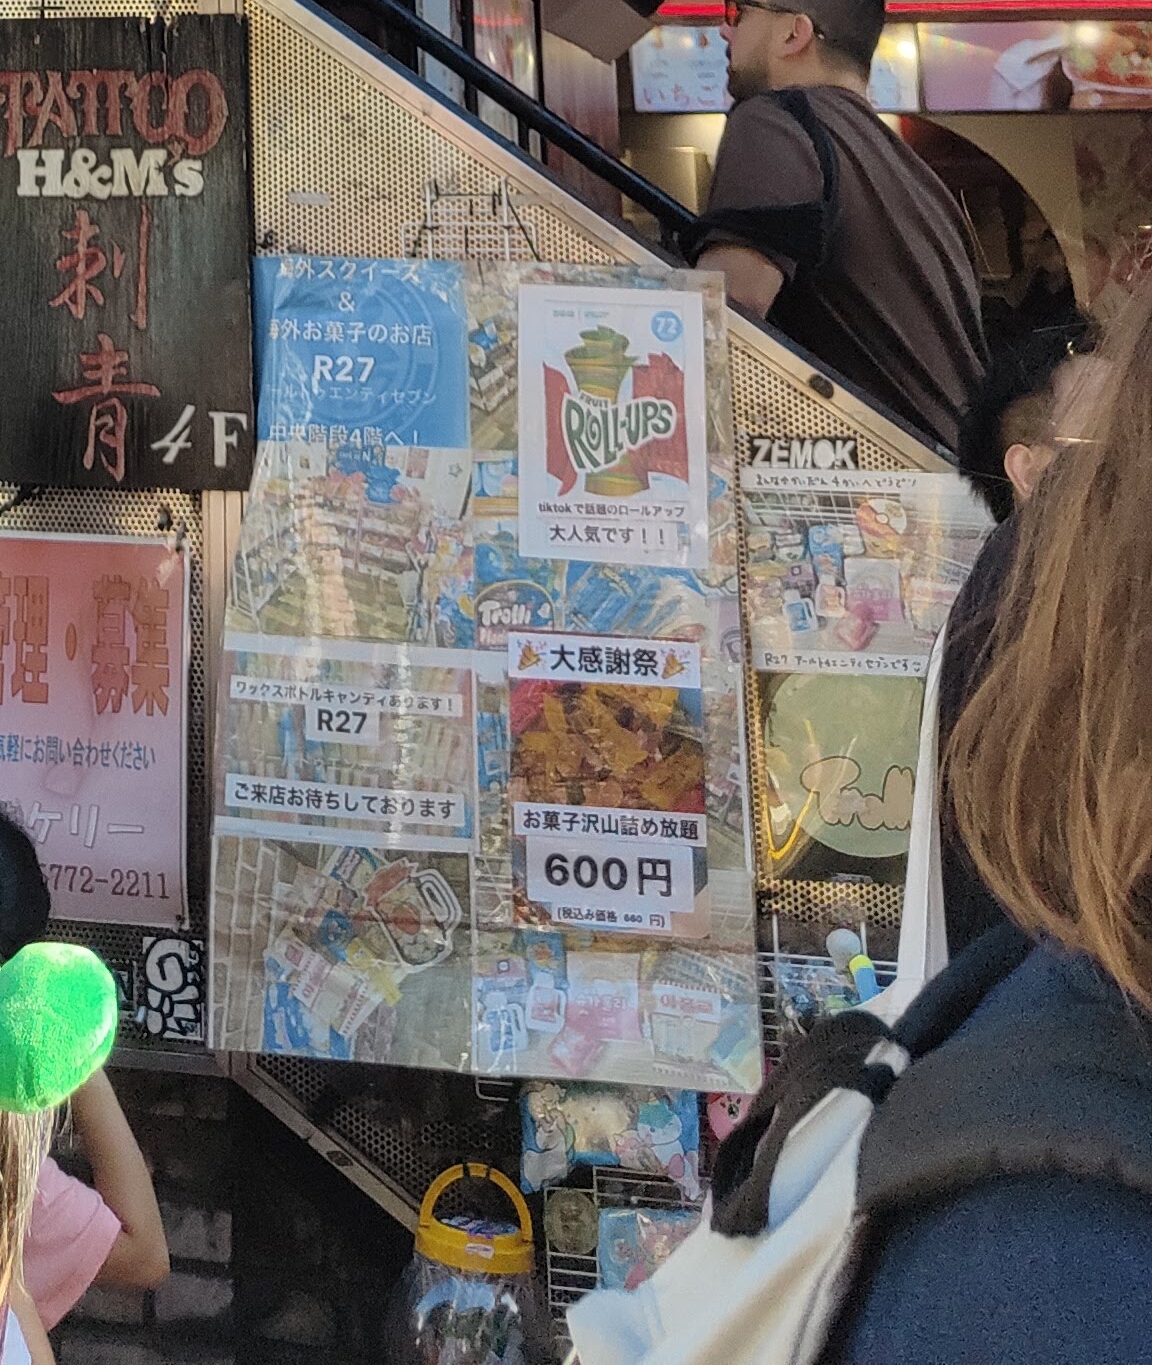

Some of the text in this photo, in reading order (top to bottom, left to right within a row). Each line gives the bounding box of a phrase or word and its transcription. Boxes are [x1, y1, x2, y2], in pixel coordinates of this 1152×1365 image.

[337, 292, 355, 312] &
[49, 206, 161, 483] 刺青
[313, 355, 375, 383] R27
[579, 394, 610, 409] FRUIT
[565, 399, 673, 469] ROLL-UPS
[753, 438, 857, 469] ZEMOK
[478, 600, 531, 626] Trolli
[550, 645, 659, 677] 大感謝祭
[764, 652, 788, 666] R27
[317, 708, 368, 734] R27
[235, 781, 456, 819] ご来店お待ちしております
[522, 809, 700, 840] お菓子沢山詰め放題
[40, 863, 169, 899] 772-2211
[545, 852, 673, 898] 600円
